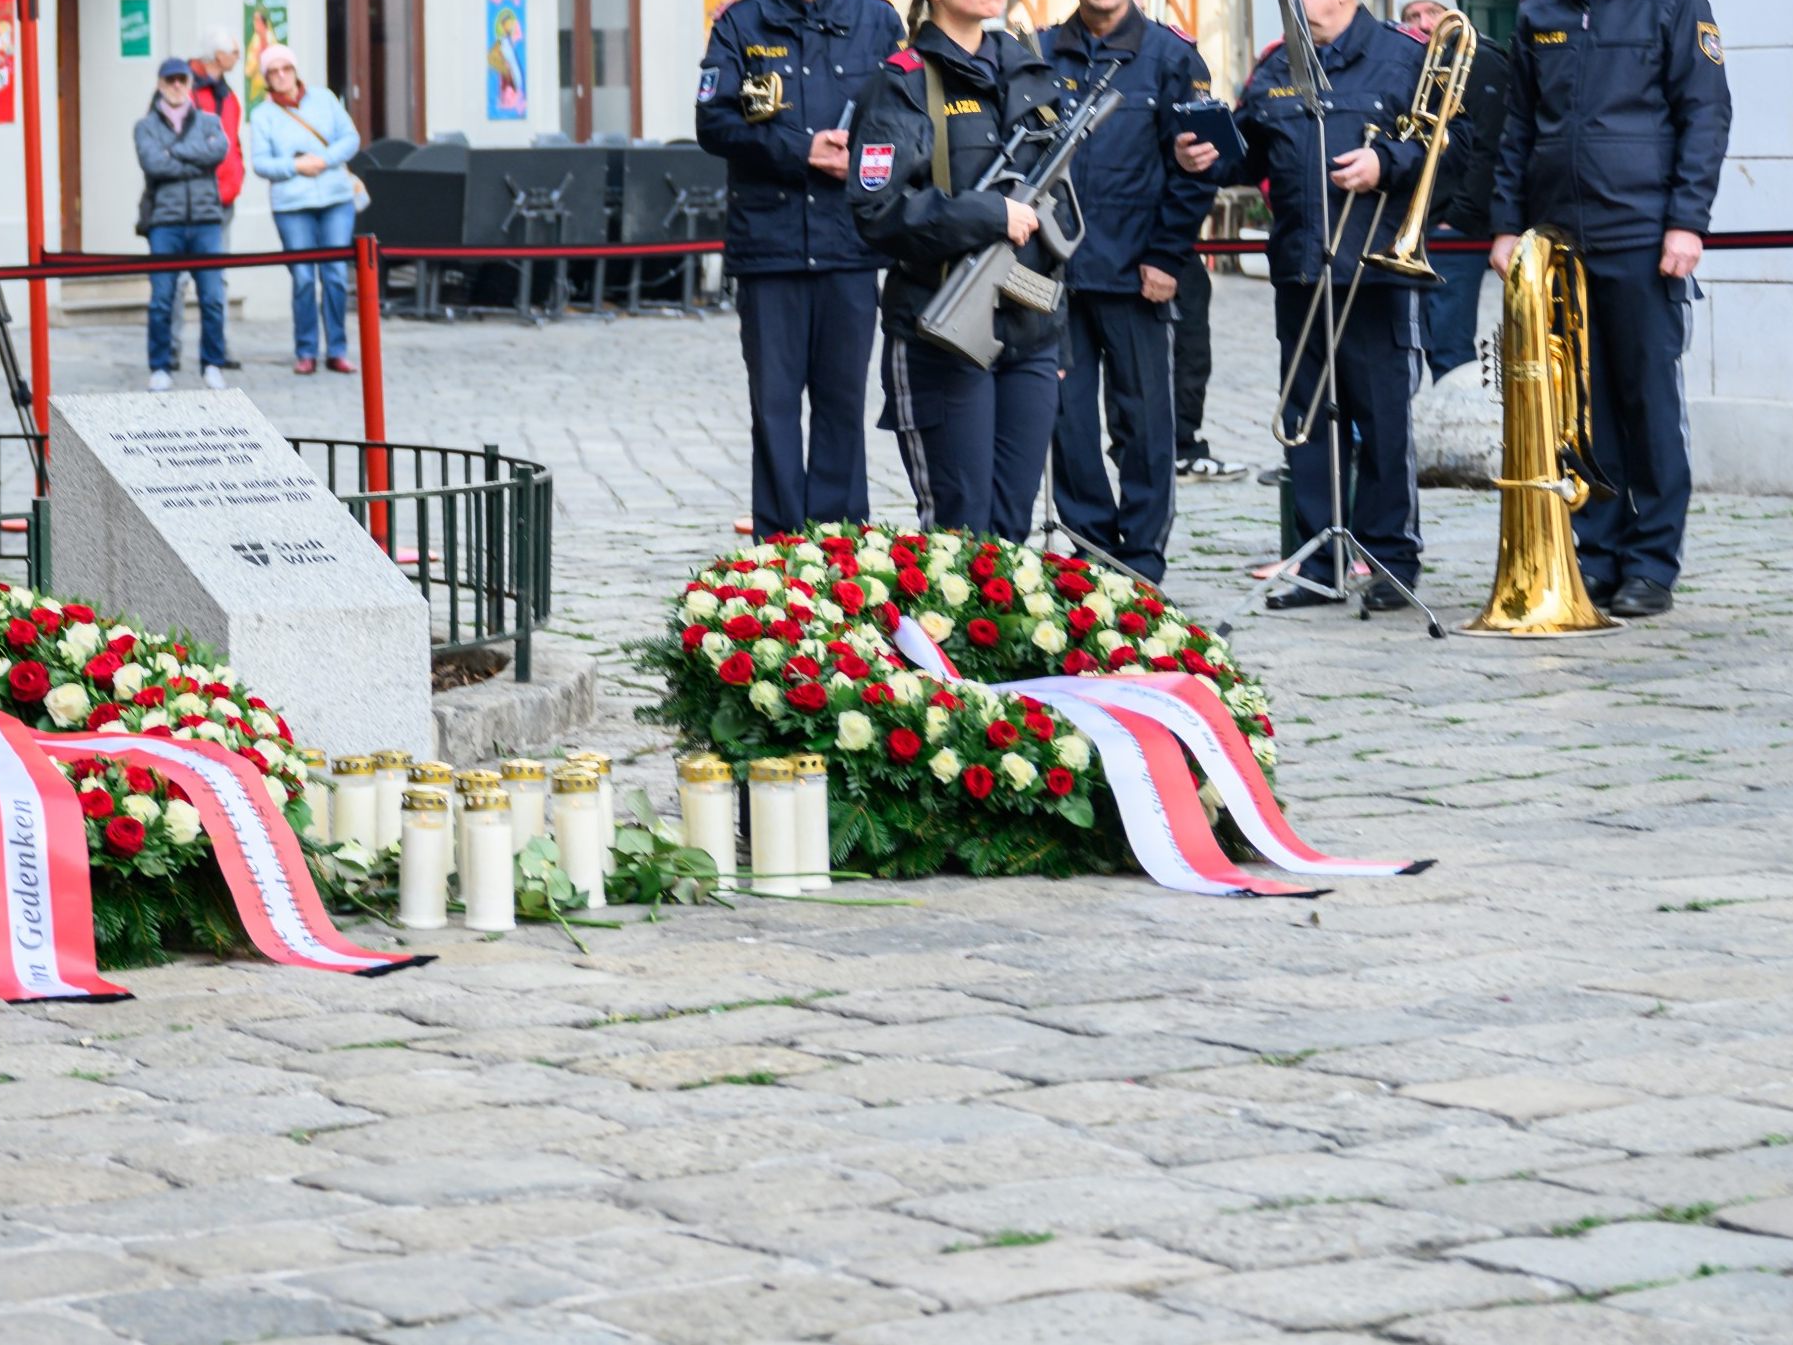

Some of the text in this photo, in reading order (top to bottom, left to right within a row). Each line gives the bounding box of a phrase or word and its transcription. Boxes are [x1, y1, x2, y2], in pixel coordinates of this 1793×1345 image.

[185, 429, 198, 439] an
[200, 426, 218, 437] die
[168, 456, 223, 468] November
[226, 454, 253, 465] 2020
[219, 479, 239, 492] the
[297, 475, 318, 488] the
[225, 493, 281, 506] November
[282, 492, 313, 504] 2020
[271, 539, 325, 552] Stadt
[280, 553, 338, 565] Wien
[9, 798, 44, 951] Gedenken
